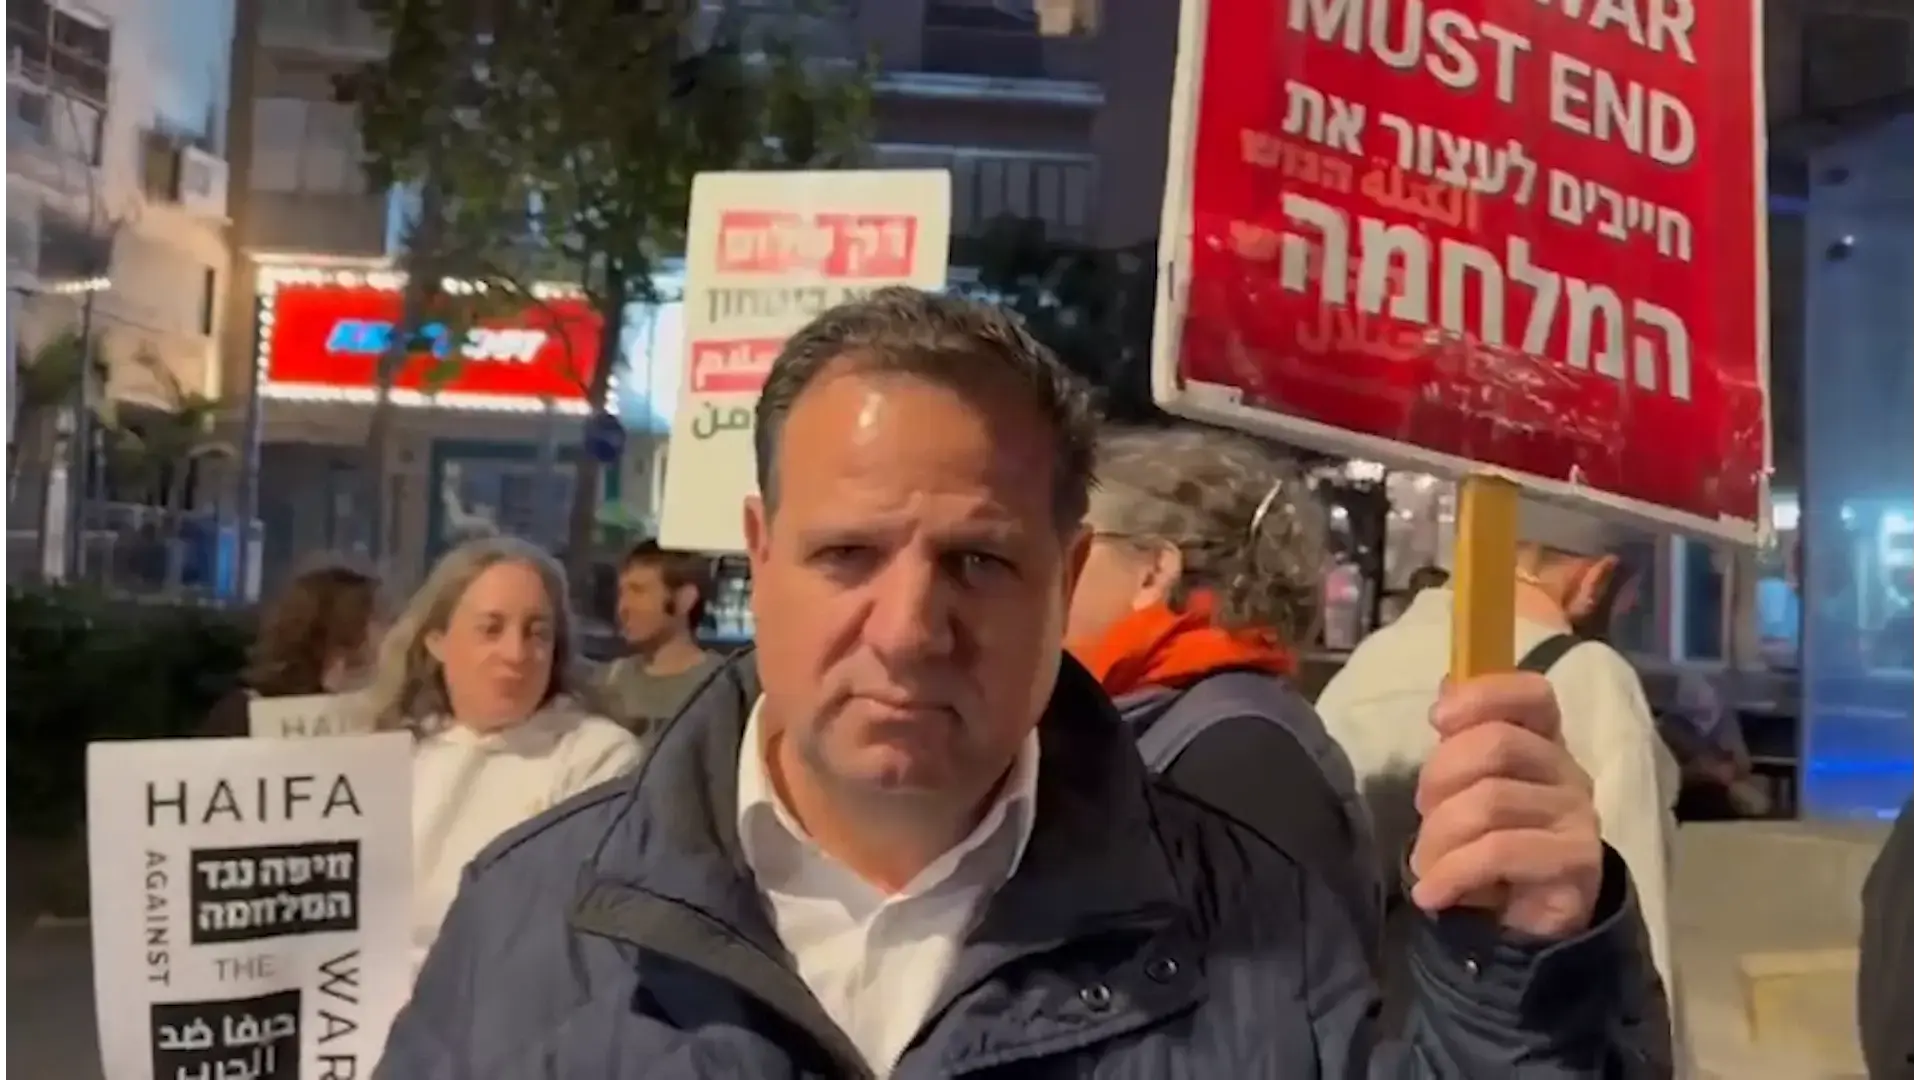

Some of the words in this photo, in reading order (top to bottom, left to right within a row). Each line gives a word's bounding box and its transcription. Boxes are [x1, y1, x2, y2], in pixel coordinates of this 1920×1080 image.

[1536, 0, 1697, 64] AR
[1286, 0, 1531, 103] MUST
[1549, 51, 1696, 166] END
[1281, 79, 1366, 157] את
[1379, 112, 1538, 205] לעצור
[1548, 168, 1693, 262] חייבים
[1279, 192, 1693, 402] המלחמה
[281, 714, 347, 738] HAI
[145, 773, 364, 828] HAIFA
[198, 859, 255, 890] נגד
[259, 852, 354, 888] חיפה
[145, 849, 171, 987] AGAINST
[199, 891, 351, 932] המלחמה
[215, 954, 276, 983] THE
[158, 1016, 214, 1051] ضد
[317, 948, 360, 1080] WAR
